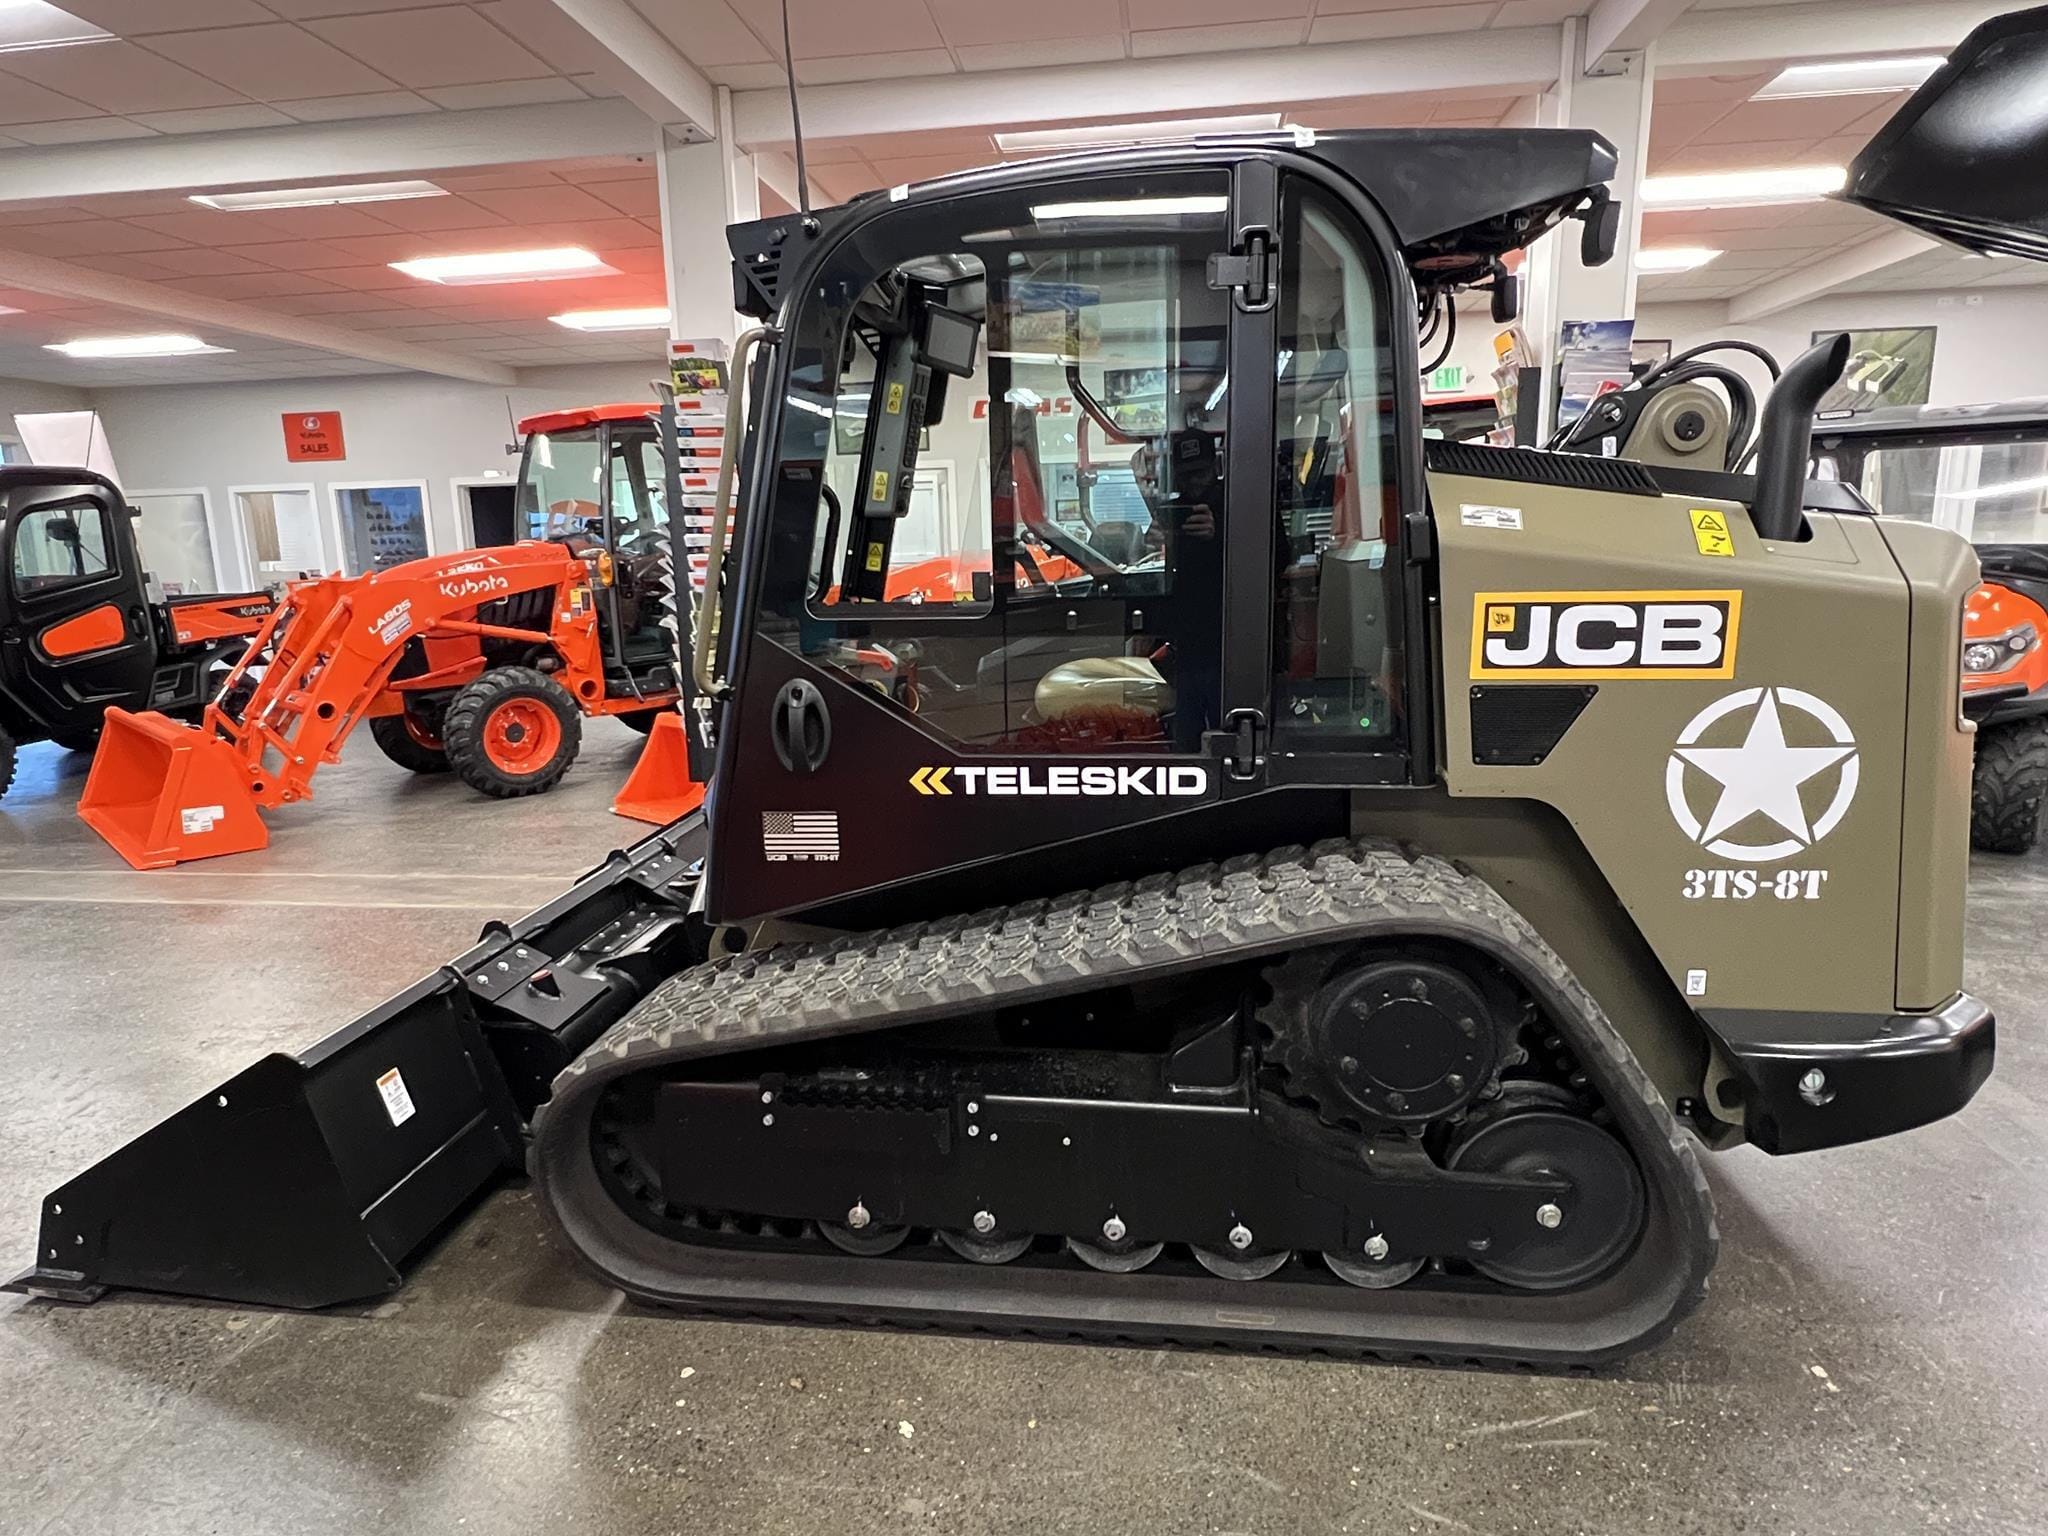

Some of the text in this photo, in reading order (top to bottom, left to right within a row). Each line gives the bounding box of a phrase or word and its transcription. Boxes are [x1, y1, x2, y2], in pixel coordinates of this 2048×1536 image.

[1435, 367, 1462, 388] EXIT
[300, 443, 329, 453] SALES
[440, 575, 508, 597] Kubota
[240, 605, 271, 616] Kubota
[1486, 604, 1723, 666] JCB
[954, 766, 1207, 795] TELESKID
[1682, 869, 1829, 900] 3TS-8T
